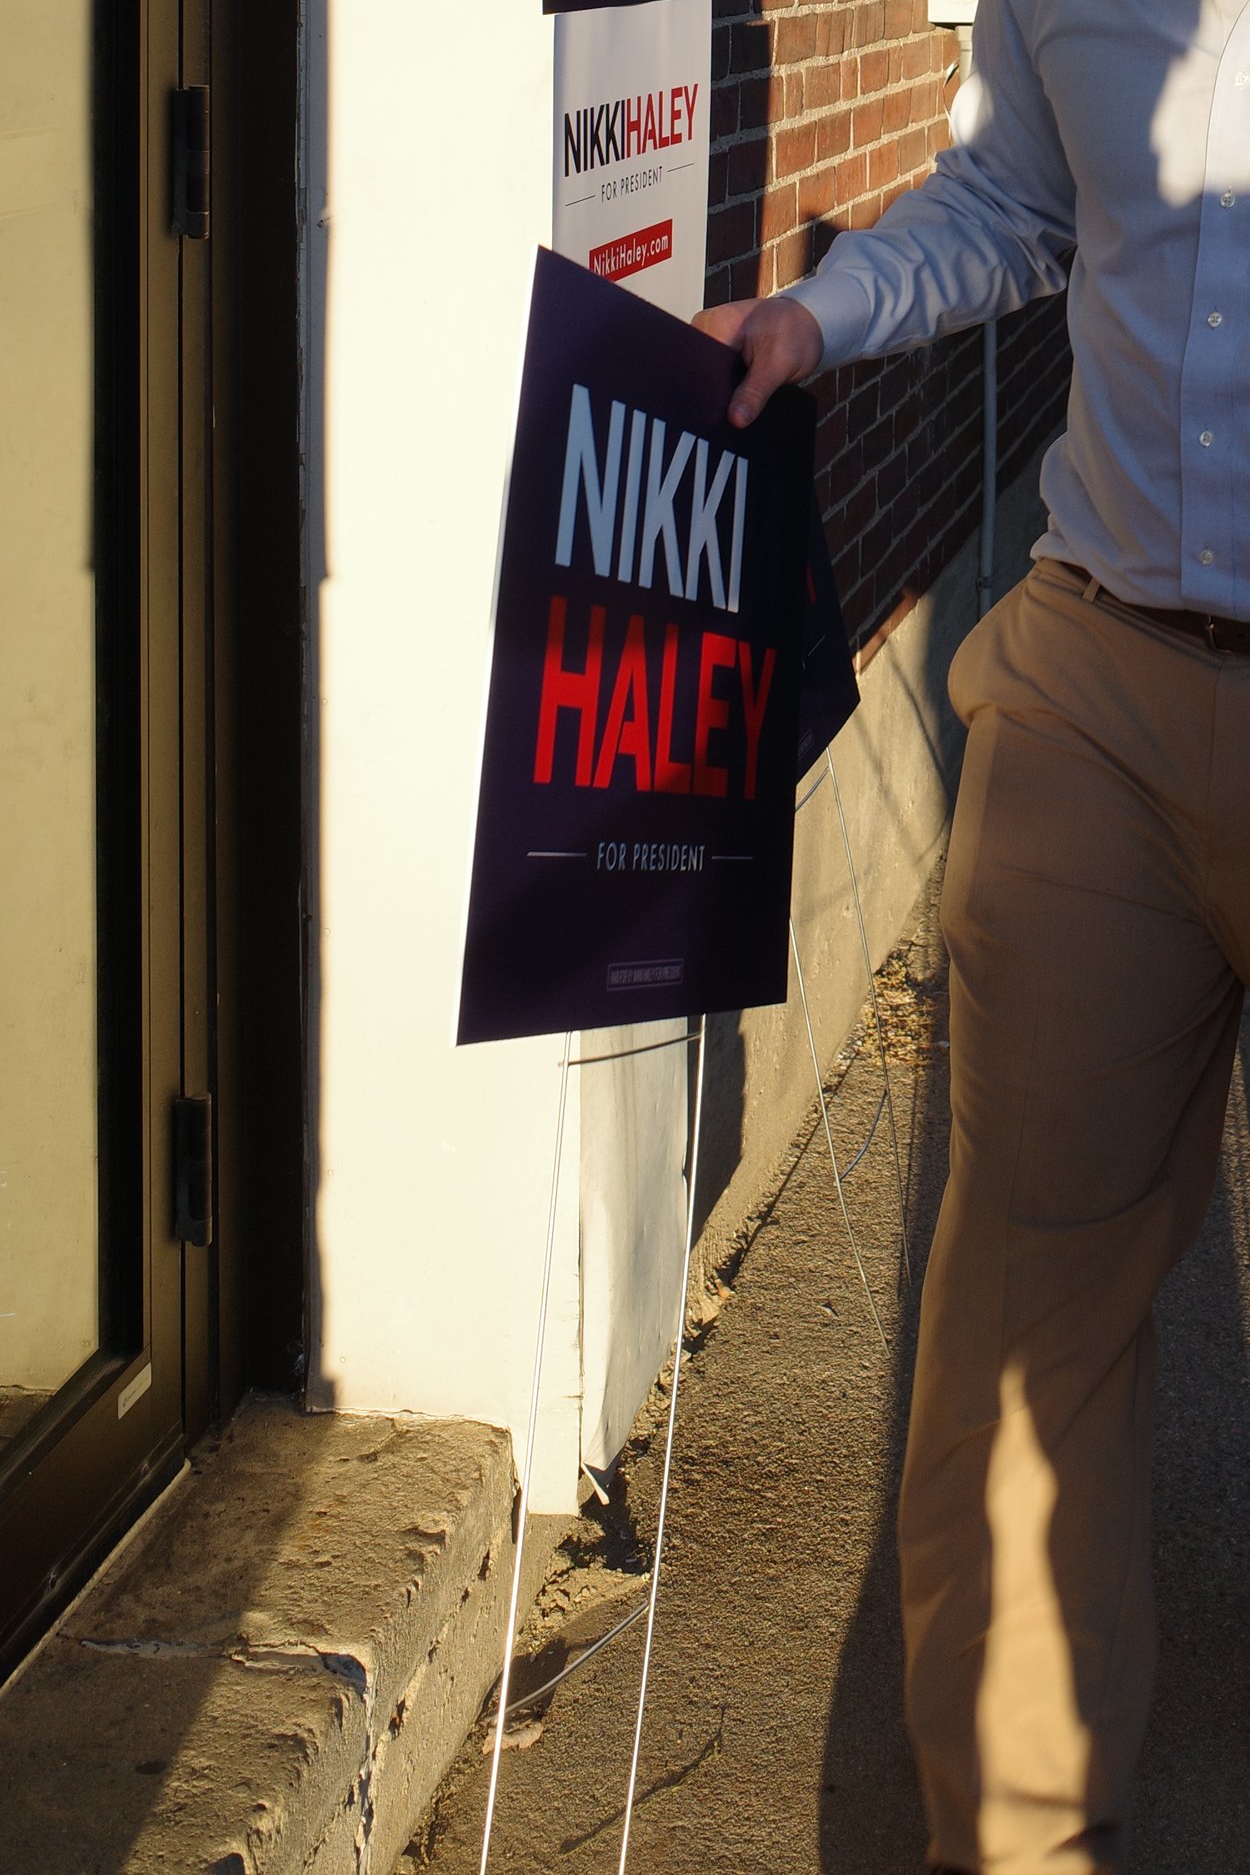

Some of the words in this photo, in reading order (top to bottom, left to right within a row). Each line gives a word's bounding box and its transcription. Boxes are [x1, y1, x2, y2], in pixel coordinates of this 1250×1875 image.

[601, 179, 618, 203] FOR
[620, 165, 663, 196] PRESIDENT
[593, 235, 669, 276] NikkiHaley.com
[555, 383, 749, 614] NIKKI
[533, 595, 777, 801] HALEY
[597, 842, 627, 871] FOR
[632, 843, 706, 872] PRESIDENT
